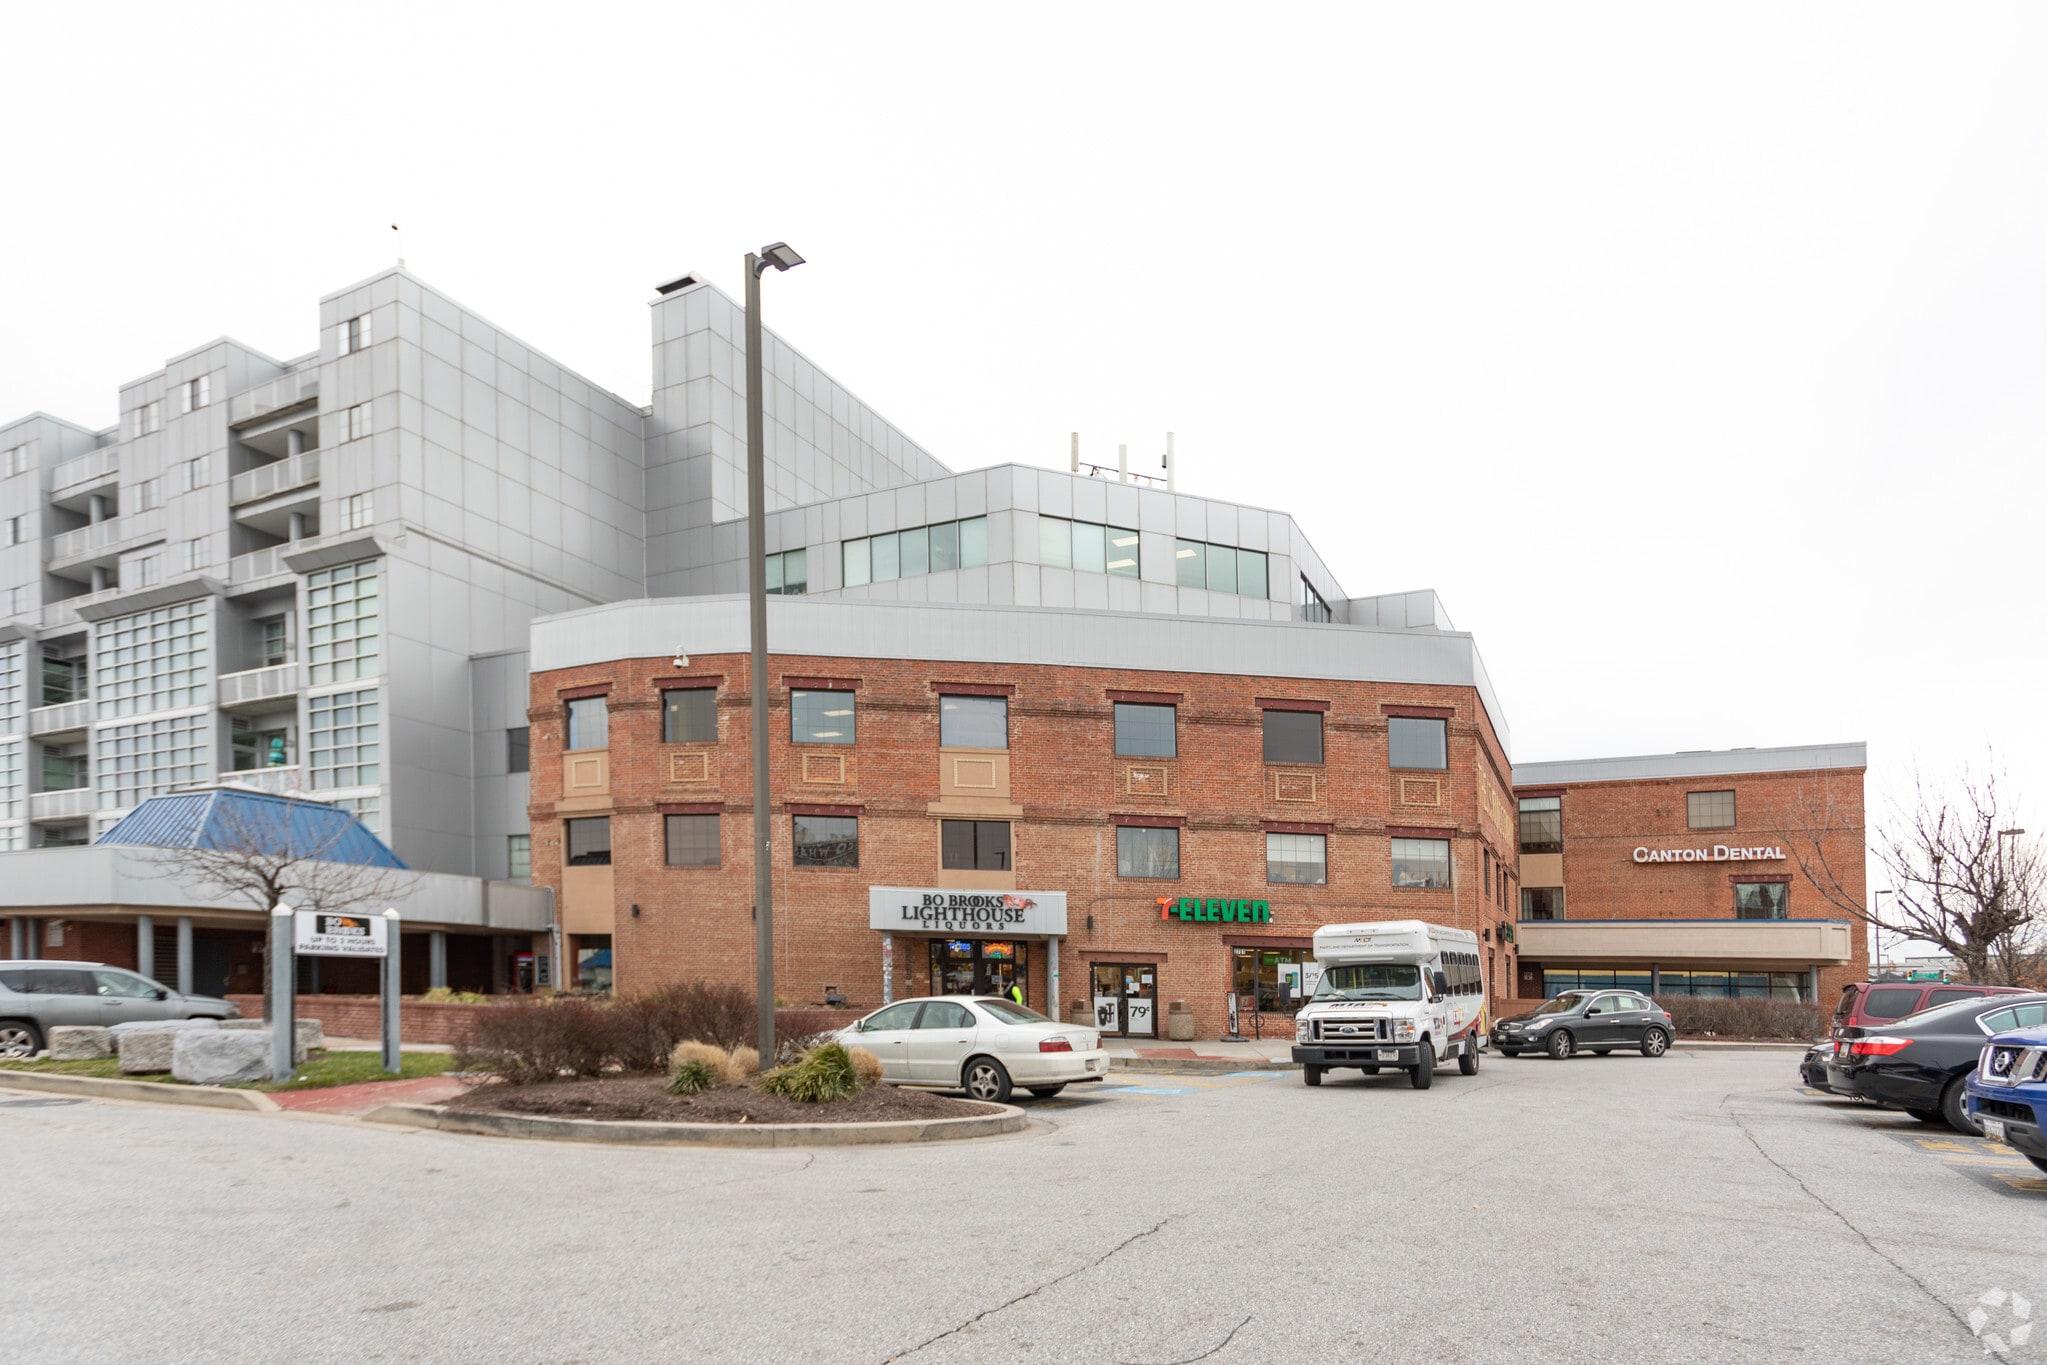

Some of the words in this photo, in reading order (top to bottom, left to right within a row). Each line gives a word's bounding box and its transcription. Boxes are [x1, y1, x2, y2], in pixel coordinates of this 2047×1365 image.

[1633, 846, 1707, 863] CANTON
[1713, 844, 1787, 861] DENTAL
[922, 894, 944, 906] BO
[948, 894, 1004, 908] BROOKS
[902, 905, 1026, 923] LIGHTHOUSE
[922, 920, 1005, 931] LIQUORS
